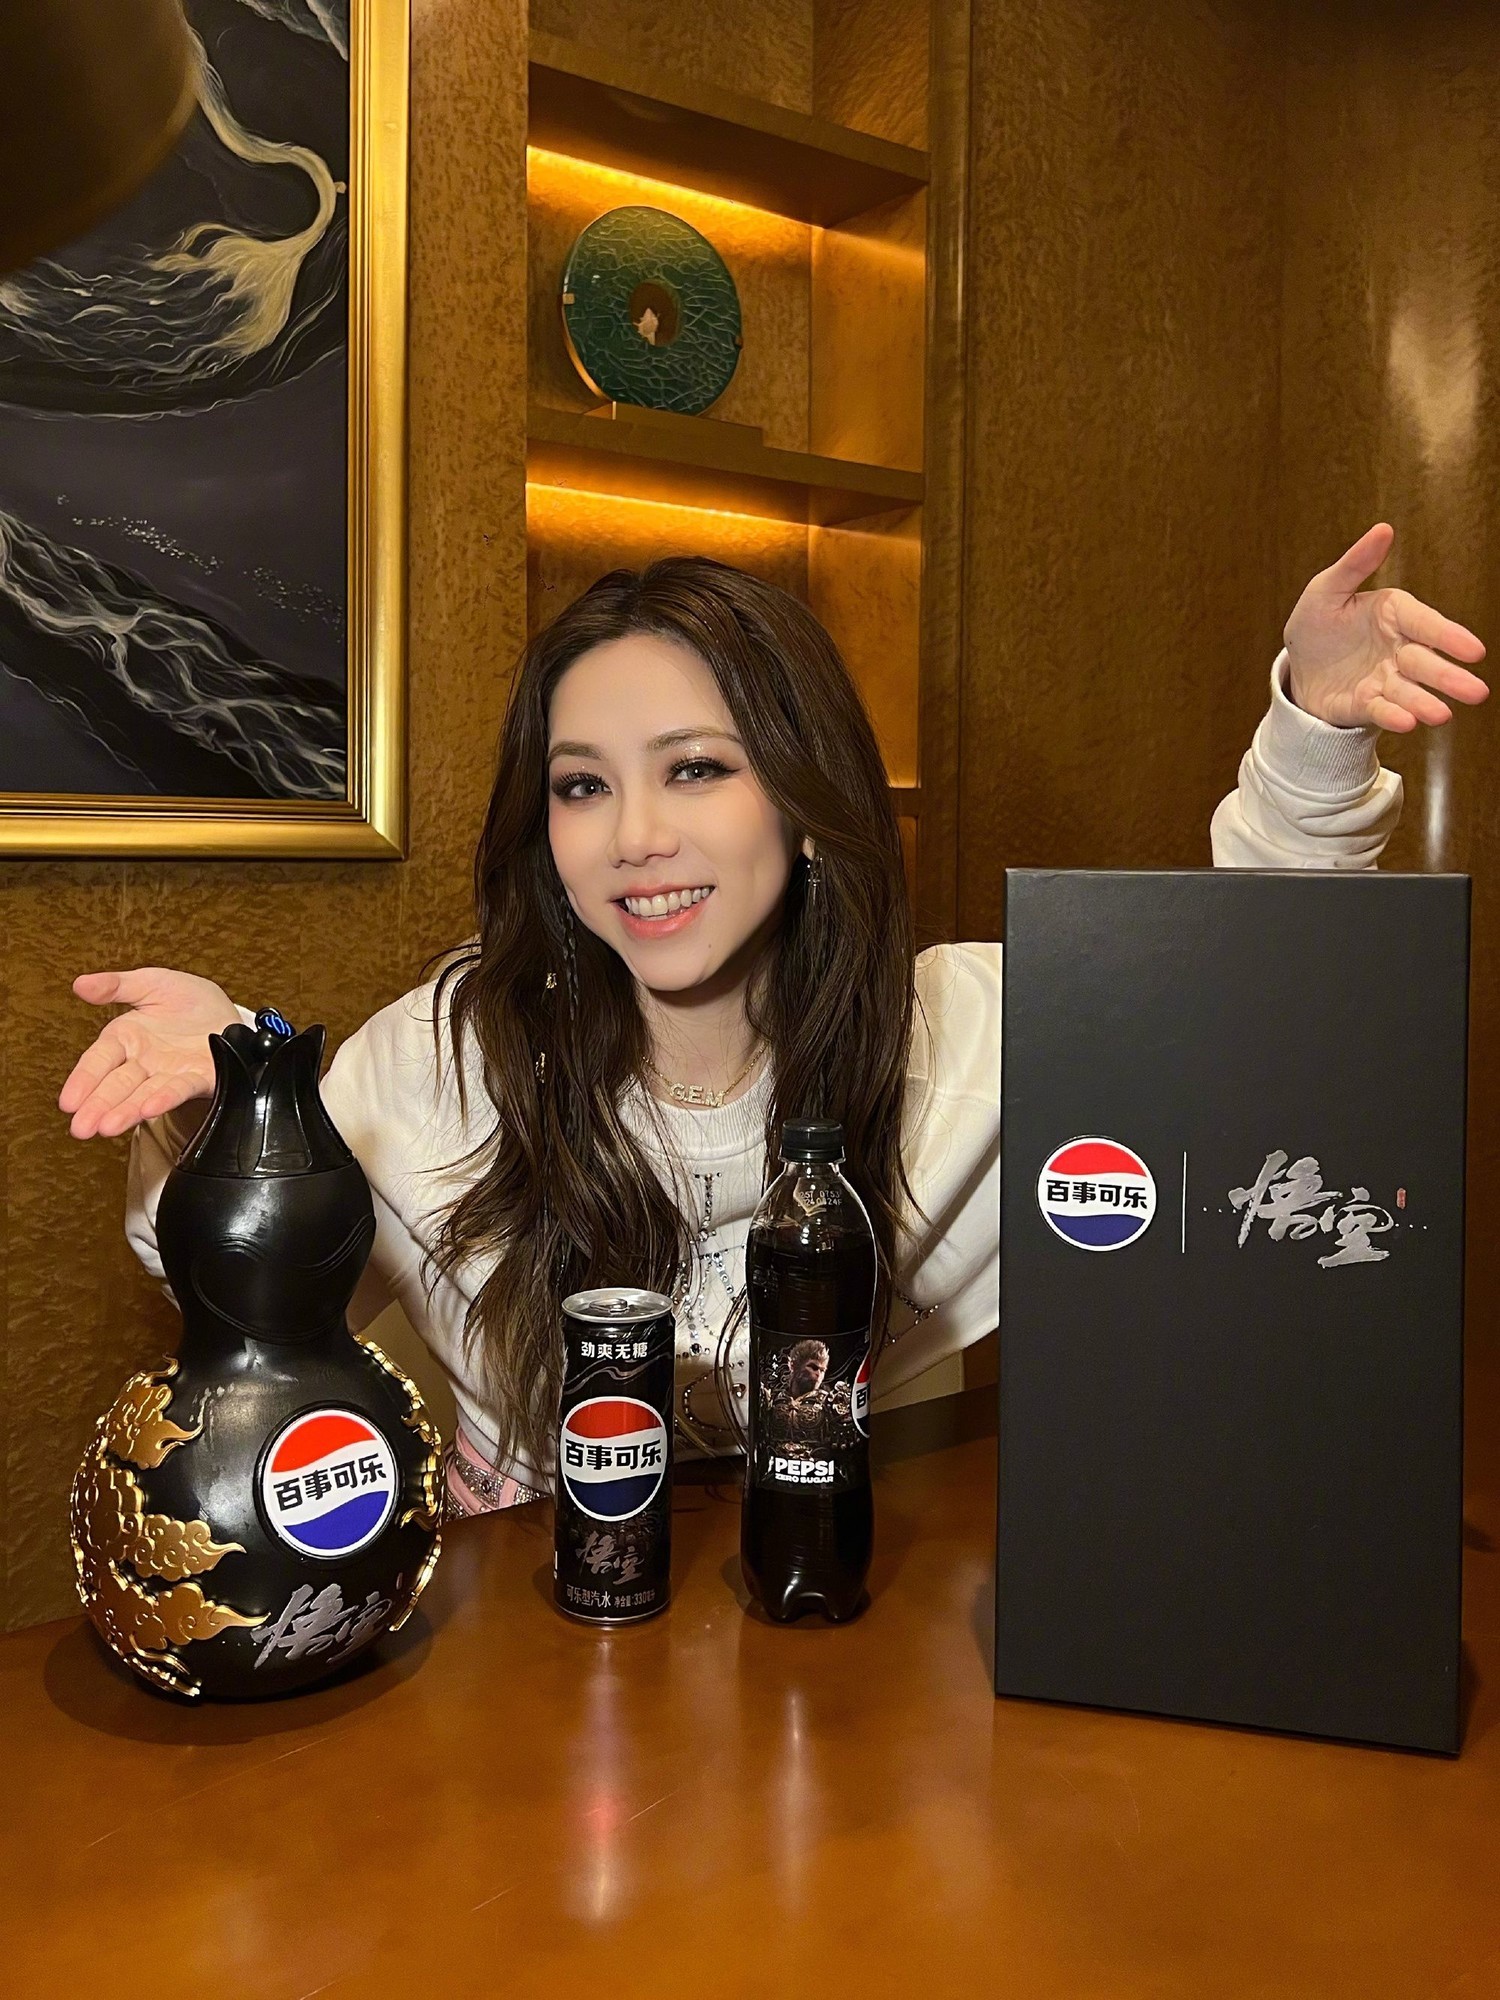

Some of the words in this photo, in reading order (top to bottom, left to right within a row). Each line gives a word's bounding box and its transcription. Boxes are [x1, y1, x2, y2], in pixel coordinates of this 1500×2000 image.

[1046, 1180, 1148, 1210] 百事可乐
[1228, 1149, 1394, 1269] 悟空
[581, 1341, 649, 1359] 劲爽无糖
[565, 1439, 663, 1470] 百事可乐
[774, 1457, 835, 1477] PEPSI
[273, 1453, 388, 1512] 百事可乐
[774, 1473, 800, 1483] ZERO
[800, 1475, 834, 1484] SUGAR
[566, 1583, 612, 1609] 可乐型汽水
